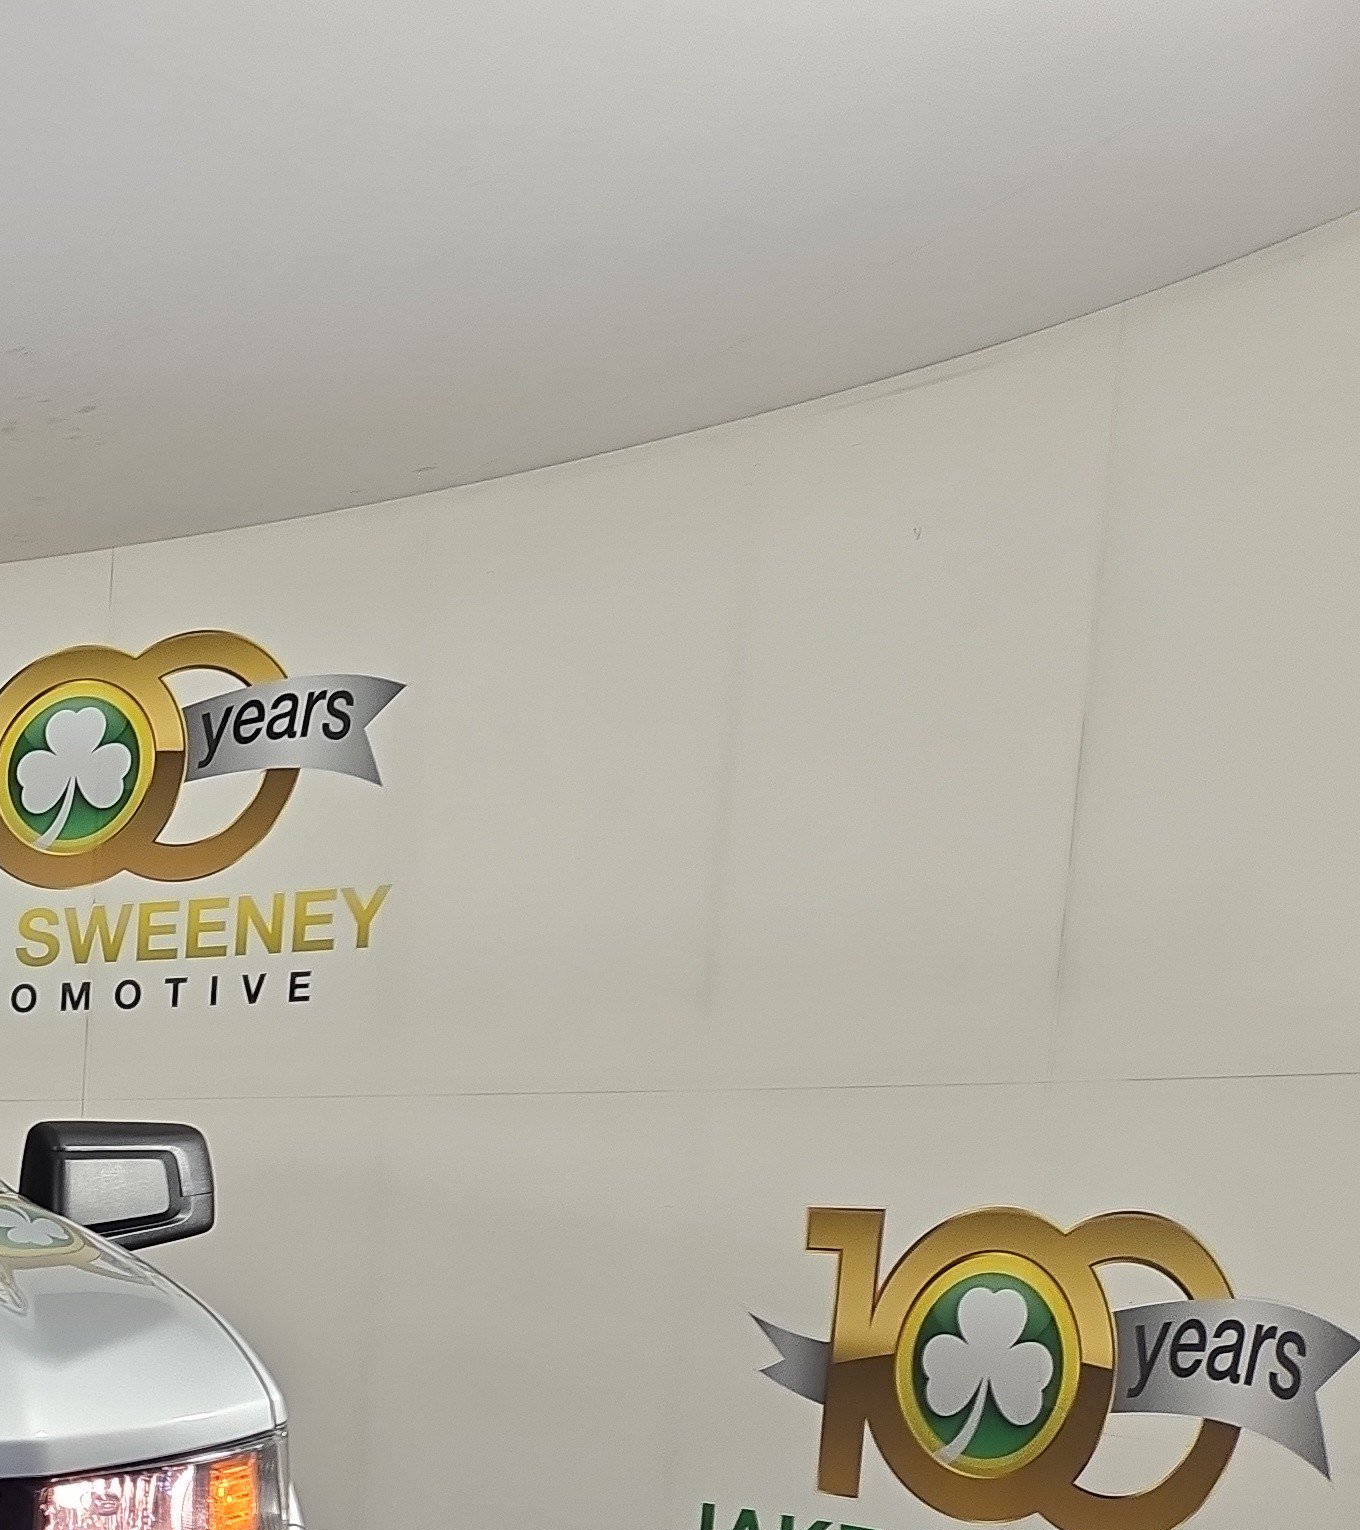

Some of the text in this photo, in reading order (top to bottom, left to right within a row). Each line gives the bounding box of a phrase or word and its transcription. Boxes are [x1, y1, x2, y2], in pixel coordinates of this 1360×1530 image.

[195, 688, 355, 769] years
[14, 884, 393, 968] SWEENEY
[1126, 1317, 1308, 1400] years
